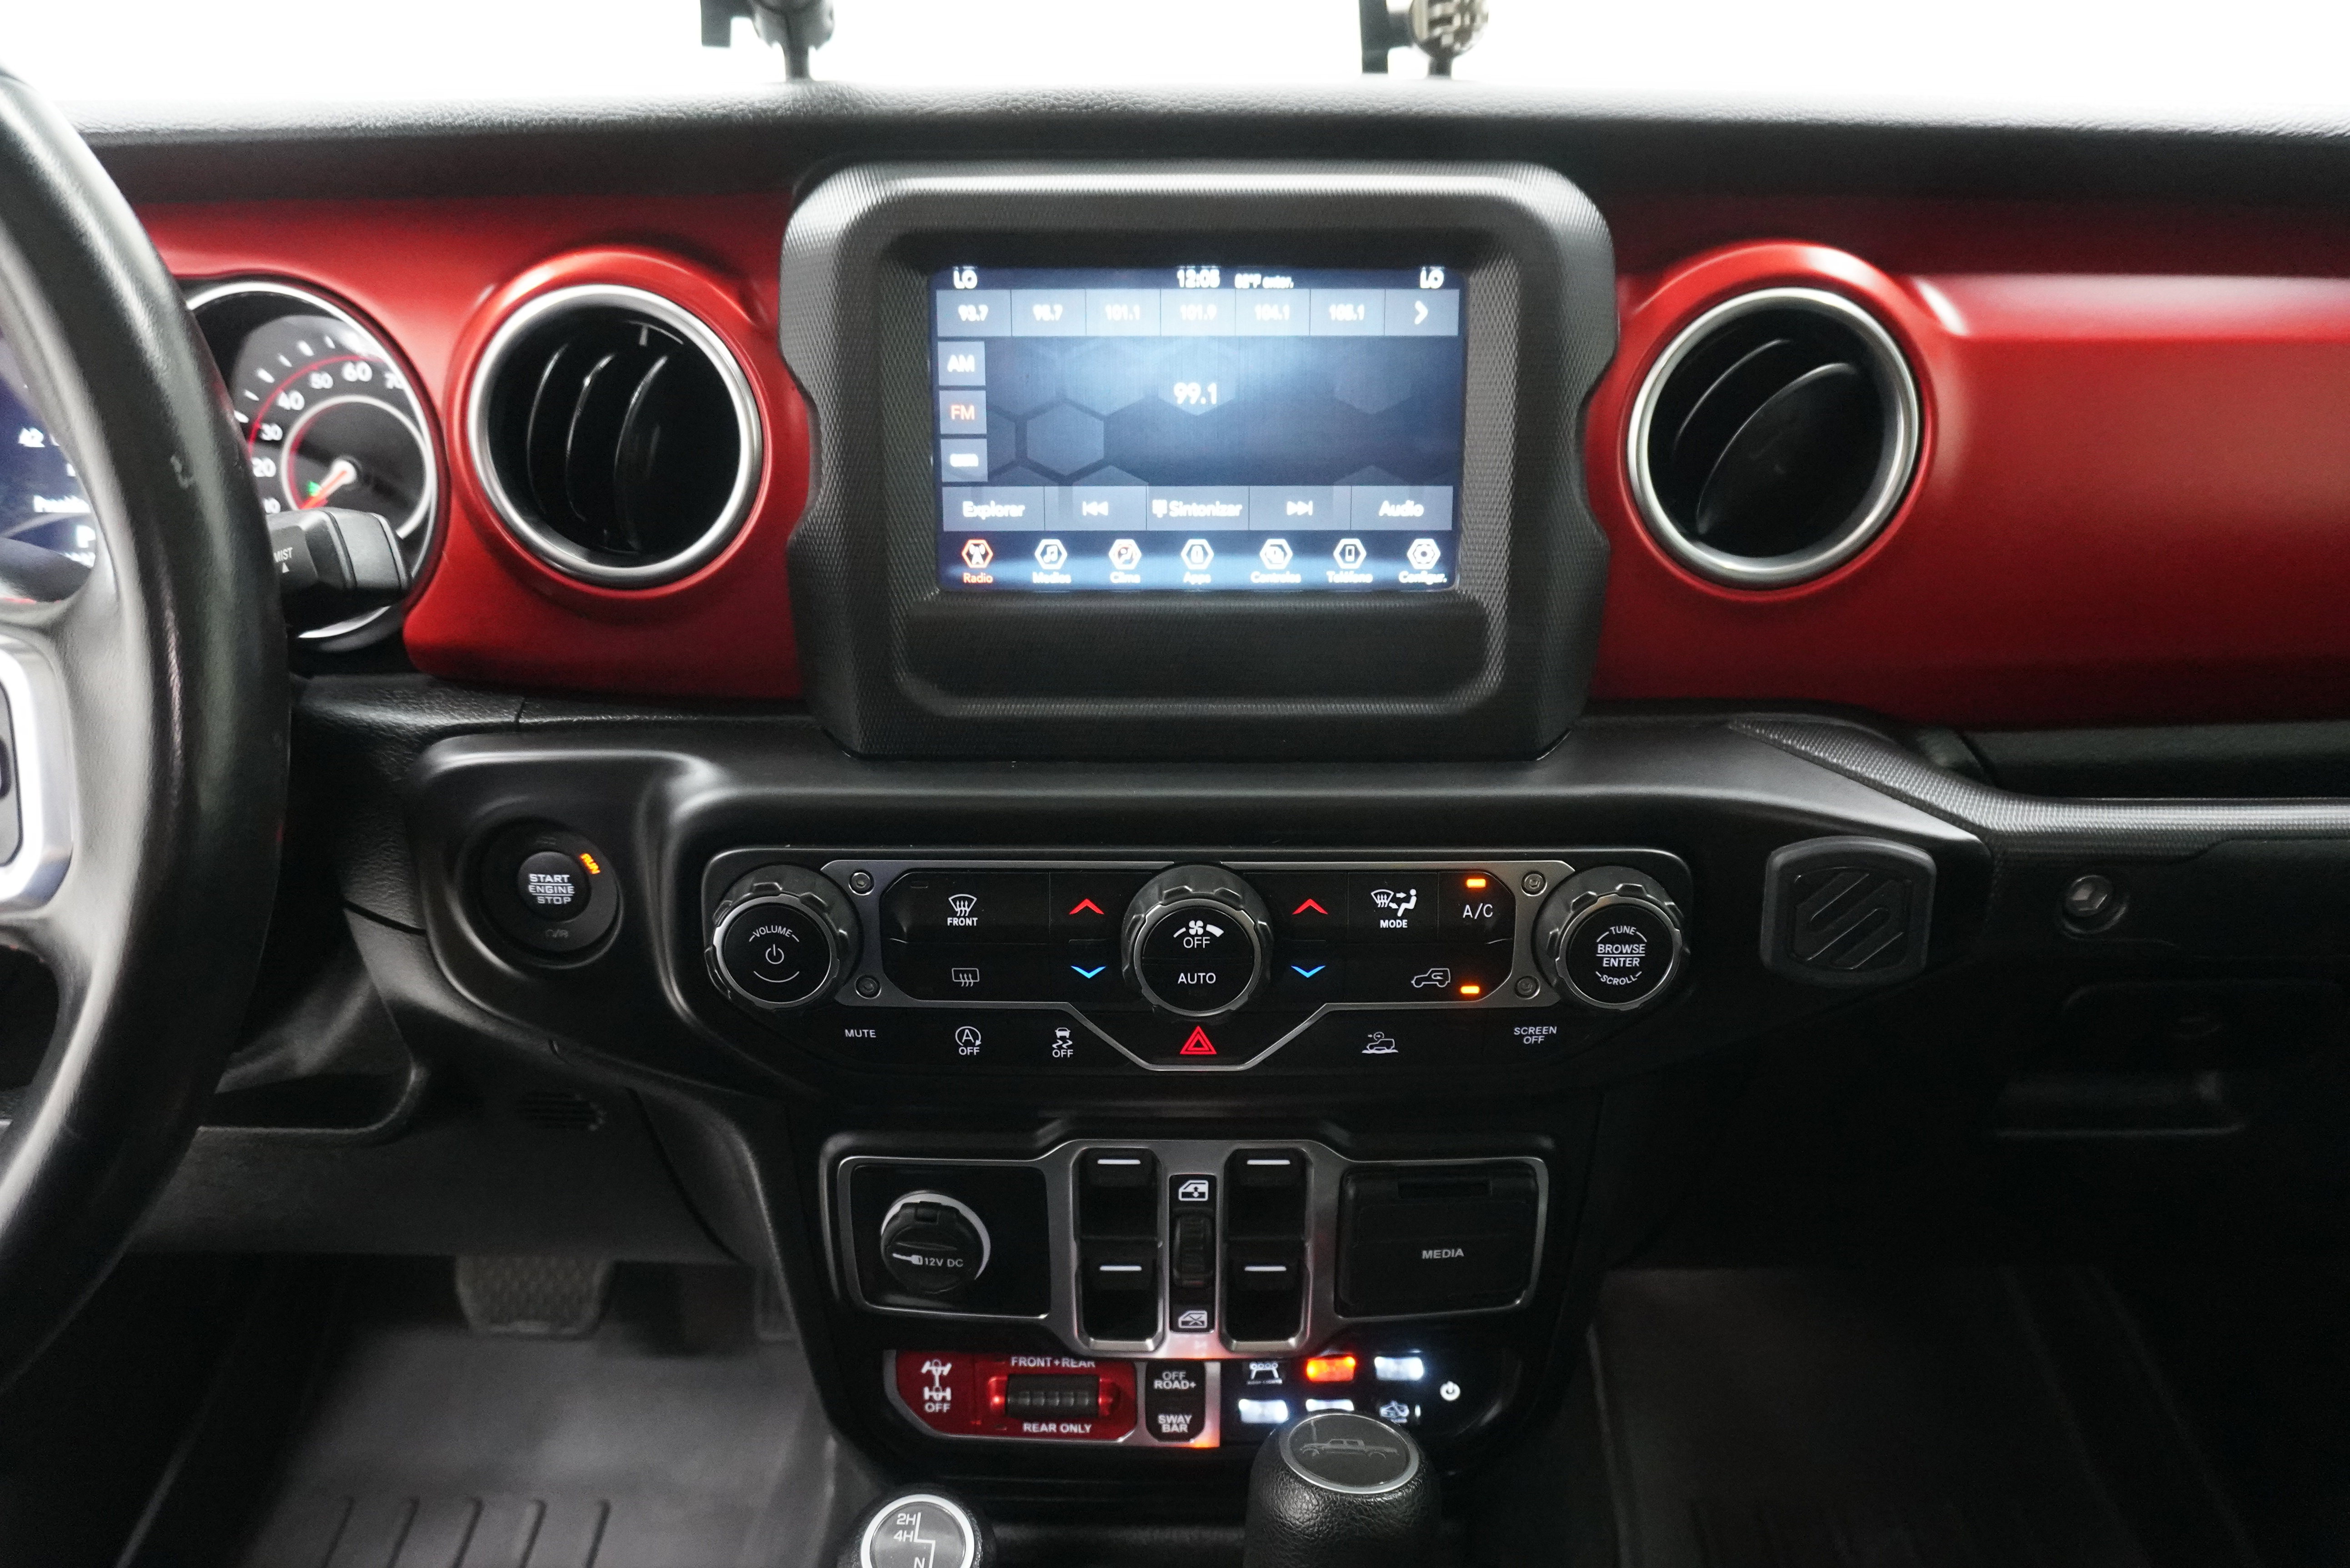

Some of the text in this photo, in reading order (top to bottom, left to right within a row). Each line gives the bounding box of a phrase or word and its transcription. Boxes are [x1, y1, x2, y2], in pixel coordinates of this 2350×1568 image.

[953, 268, 978, 289] LO
[1177, 268, 1220, 288] 12:05
[1420, 269, 1445, 289] LO
[1105, 305, 1140, 321] 101.1
[947, 355, 975, 372] AM
[342, 361, 373, 382] 60
[310, 372, 334, 389] 50
[1173, 382, 1217, 405] 99.1
[277, 390, 305, 411] 40
[950, 405, 975, 420] FM
[260, 423, 283, 441] 30
[251, 457, 276, 477] 20
[1378, 500, 1425, 517] Audio
[274, 547, 293, 563] MIST
[963, 572, 993, 583] Radio
[1110, 572, 1141, 583] Clima
[1183, 571, 1211, 585] Apps
[581, 853, 600, 874] RUN
[529, 874, 570, 883] START
[529, 885, 575, 894] ENGINE
[537, 896, 572, 905] STOP
[1463, 904, 1493, 919] A/C
[947, 917, 978, 926] FRONT
[1380, 920, 1408, 928] MODE
[753, 926, 793, 938] VOLUME
[1610, 925, 1637, 935] TUNE
[1183, 937, 1210, 949] OFF
[1597, 943, 1646, 955] BROWSE
[1603, 957, 1640, 968] ENTER
[1178, 973, 1216, 985] AUTO
[1601, 974, 1639, 985] SCROLL
[845, 1030, 877, 1038] MUTE
[1514, 1026, 1557, 1035] SCREEN
[1523, 1036, 1544, 1045] OFF
[959, 1047, 980, 1056] OFF
[1052, 1049, 1074, 1058] OFF
[1422, 1248, 1465, 1259] MEDIA
[925, 1258, 964, 1267] 12V DC
[1161, 1371, 1186, 1380] OFF
[1154, 1380, 1196, 1389] ROAD+
[925, 1403, 950, 1412] OFF
[1158, 1414, 1192, 1424] SWAY
[1024, 1422, 1092, 1433] REAR ONLY
[1161, 1424, 1188, 1433] BAR
[897, 1513, 916, 1525] 2H
[894, 1530, 914, 1542] 4H
[914, 1557, 925, 1568] N
